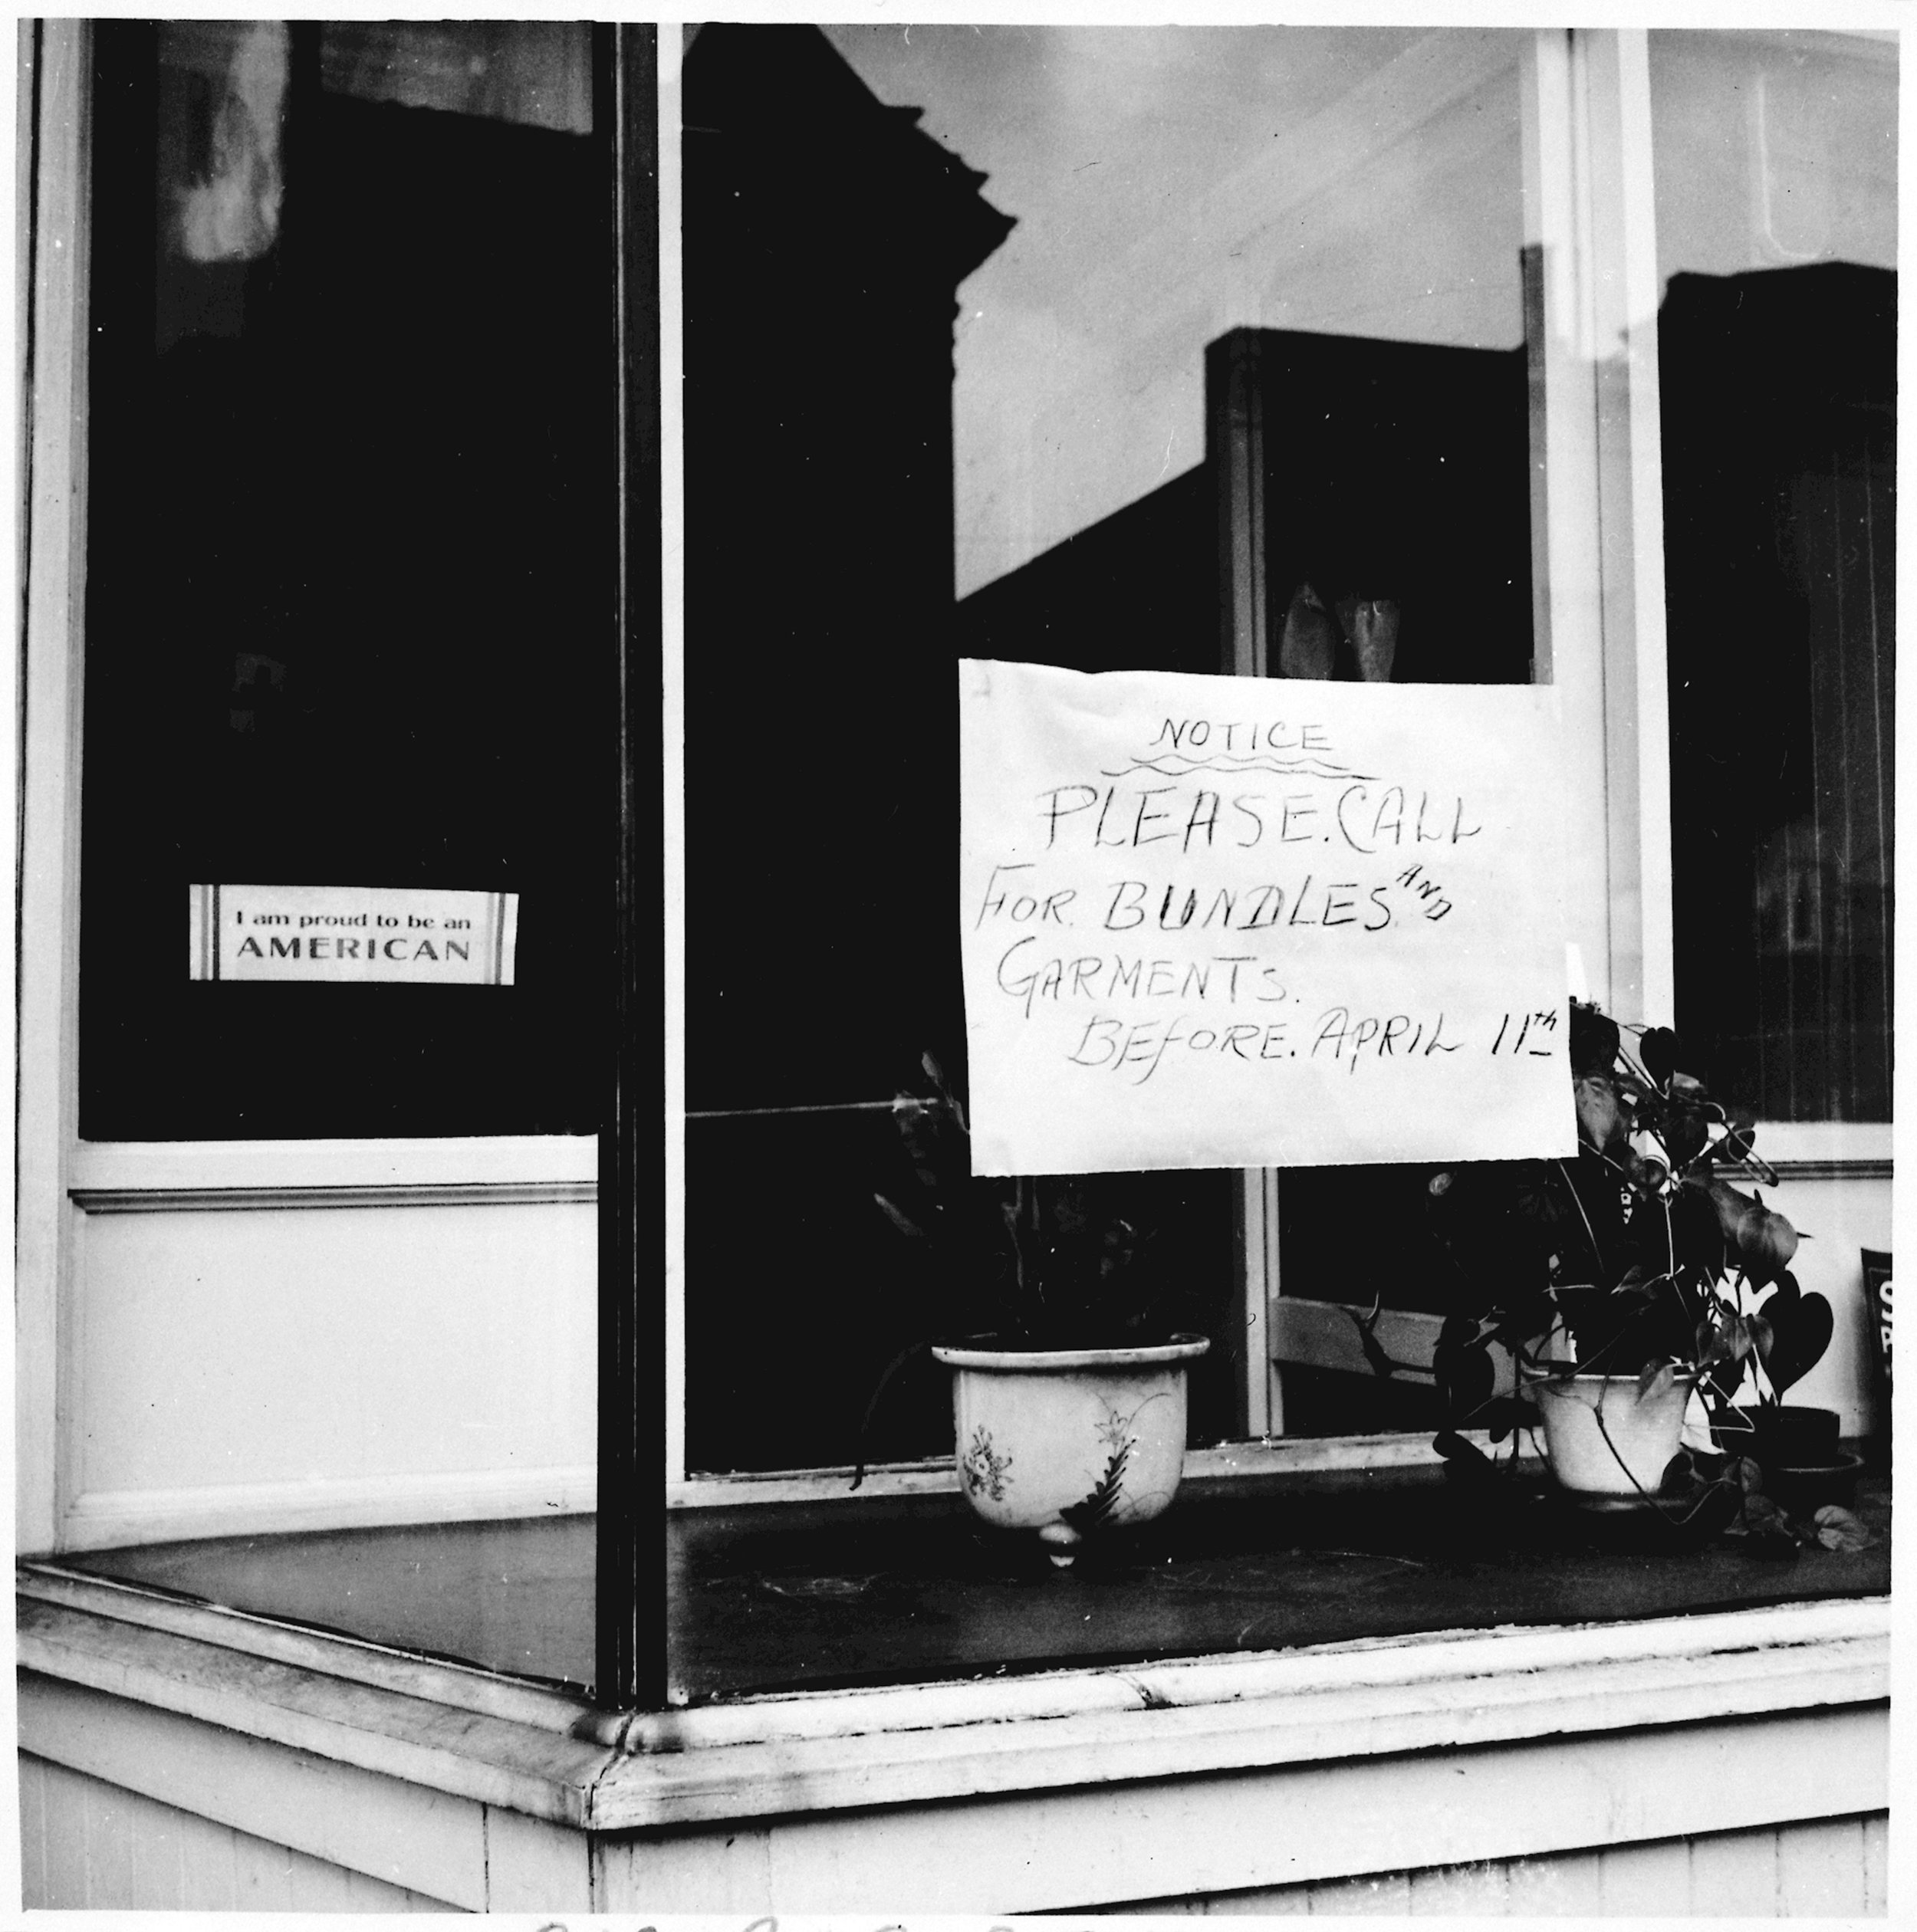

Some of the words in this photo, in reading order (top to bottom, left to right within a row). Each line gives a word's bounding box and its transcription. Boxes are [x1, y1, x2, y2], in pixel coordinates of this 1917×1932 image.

[1149, 718, 1332, 751] NOTICE
[1337, 784, 1482, 854] CALL
[1396, 863, 1453, 922] AND
[236, 910, 243, 925] I
[252, 914, 291, 927] am
[299, 913, 367, 930] proud
[376, 914, 400, 929] to
[407, 914, 435, 929] be
[443, 918, 472, 930] an
[237, 936, 469, 962] AMERICAN
[1311, 1007, 1463, 1075] APRIL
[1491, 1009, 1557, 1057] 11th
